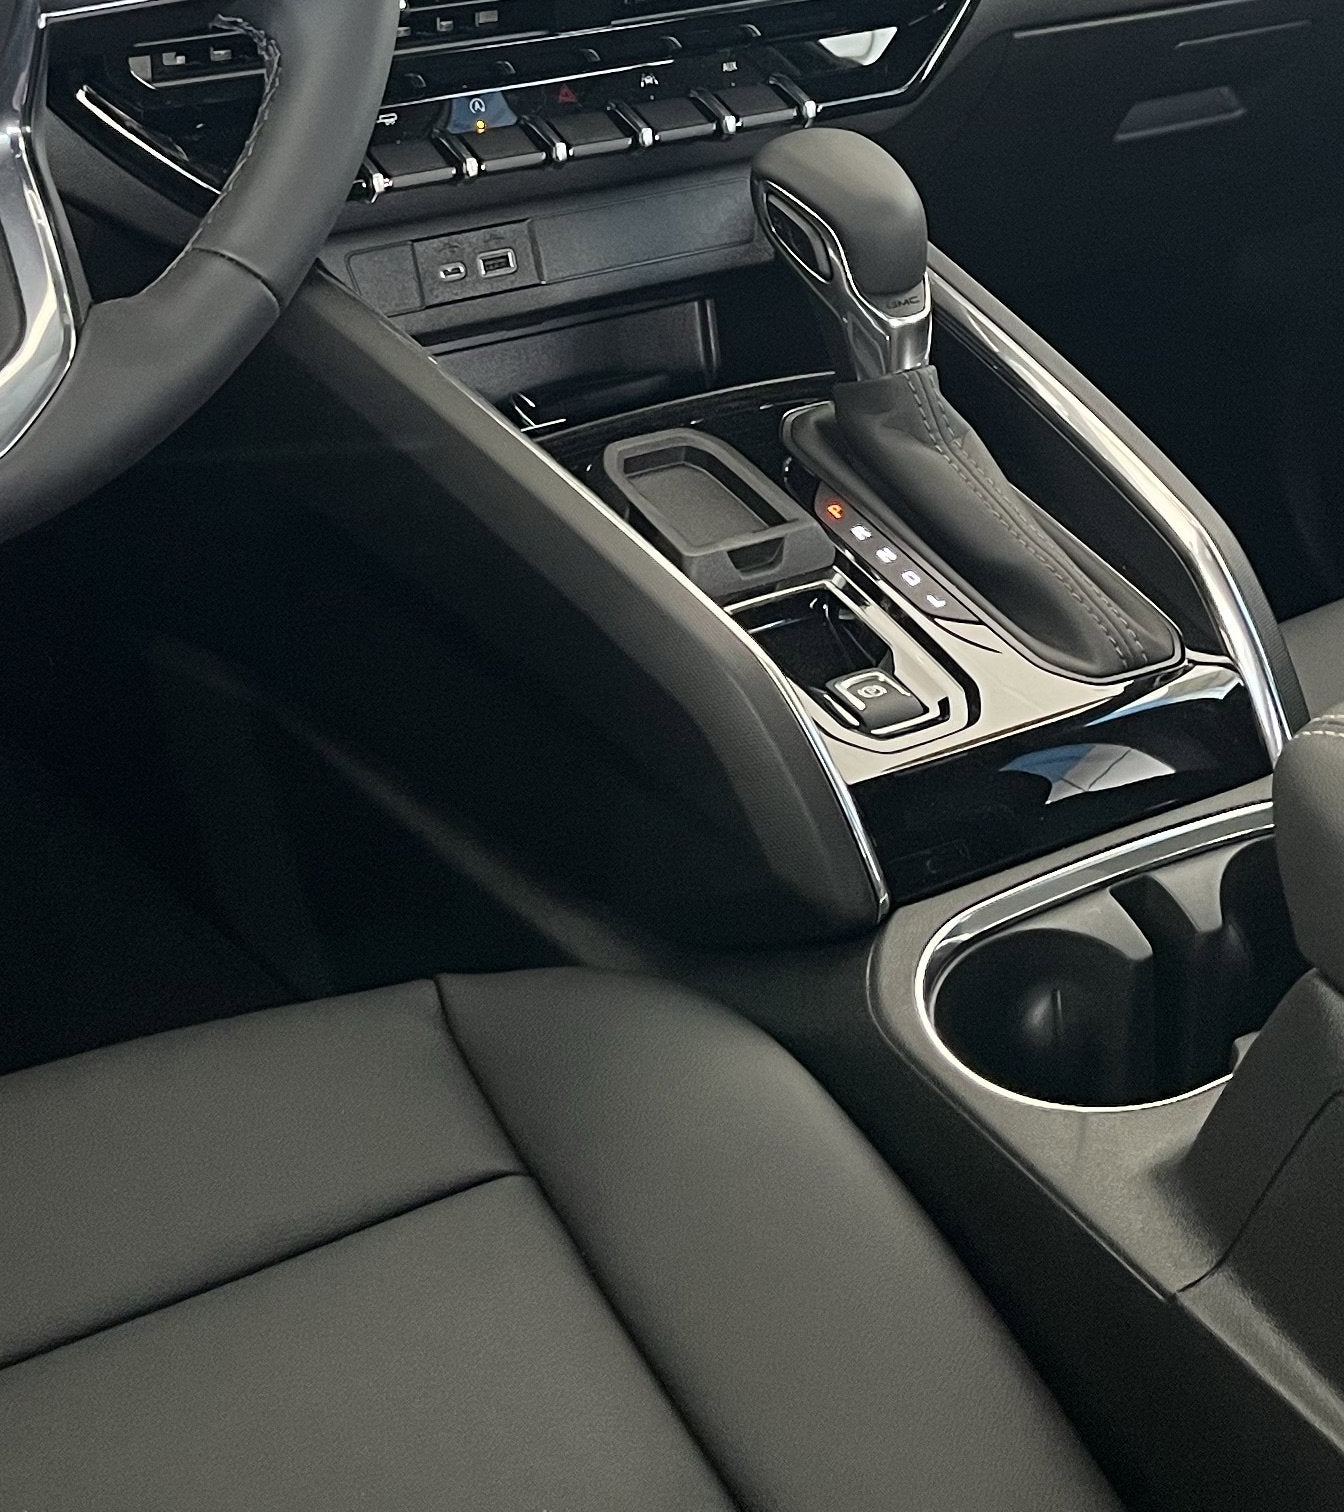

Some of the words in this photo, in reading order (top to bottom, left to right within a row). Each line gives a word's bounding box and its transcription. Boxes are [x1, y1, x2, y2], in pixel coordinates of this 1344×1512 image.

[826, 503, 843, 519] P
[876, 546, 897, 563] N
[902, 570, 921, 586] D
[926, 593, 946, 608] L
